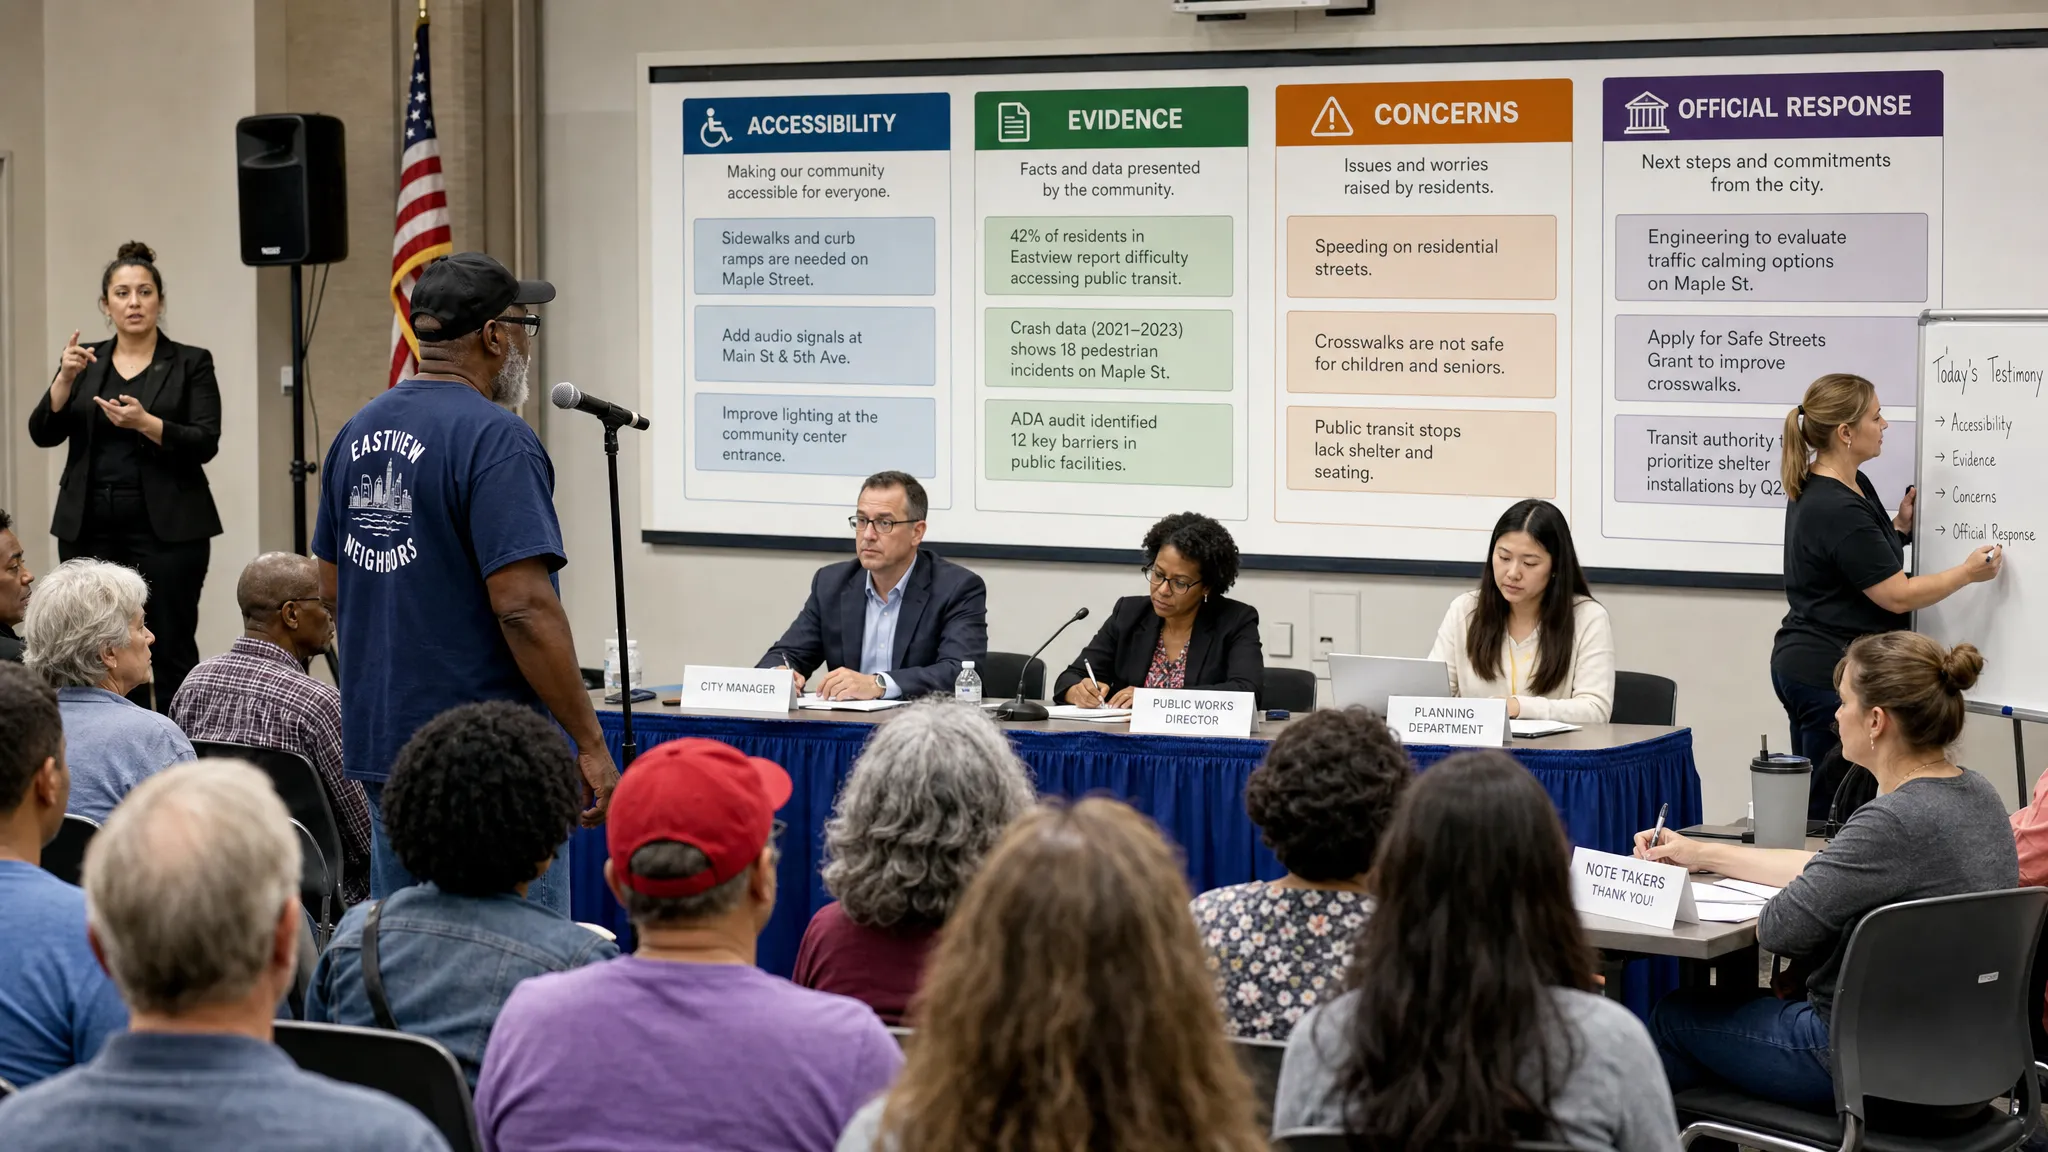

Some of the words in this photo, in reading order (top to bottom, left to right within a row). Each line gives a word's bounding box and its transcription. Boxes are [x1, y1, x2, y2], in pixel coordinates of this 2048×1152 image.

[1374, 100, 1519, 126] CONCERNS
[1678, 96, 1779, 120] OFFICIAL
[1786, 94, 1912, 118] RESPONSE
[746, 113, 897, 136] ACCESSIBILITY
[1068, 107, 1183, 131] EVIDENCE
[727, 164, 776, 182] Making
[780, 167, 804, 178] our
[807, 162, 885, 181] community
[1020, 161, 1058, 176] Facts
[1061, 160, 1088, 176] and
[1091, 160, 1123, 176] data
[1127, 159, 1201, 179] presented
[1344, 157, 1392, 173] Issues
[1396, 156, 1425, 172] and
[1429, 156, 1489, 172] worries
[1642, 153, 1681, 170] Next
[1686, 154, 1732, 173] steps
[1736, 152, 1768, 169] and
[1773, 152, 1891, 169] commitments
[727, 184, 798, 200] accessible
[801, 184, 822, 199] for
[824, 187, 890, 202] everyone.
[1043, 182, 1060, 201] by
[1063, 182, 1088, 197] the
[1091, 181, 1175, 200] community.
[1344, 179, 1390, 195] raised
[1395, 179, 1414, 199] by
[1418, 178, 1494, 195] residents.
[1710, 175, 1750, 193] from
[1755, 175, 1784, 192] the
[1789, 175, 1824, 196] city.
[721, 230, 790, 245] Sidewalks
[794, 230, 820, 245] and
[824, 230, 856, 245] curb
[1009, 228, 1041, 243] 42%
[1044, 228, 1060, 243] of
[1063, 228, 1128, 243] residents
[1132, 228, 1145, 243] in
[1648, 228, 1750, 249] Engineering
[1754, 230, 1772, 245] to
[1777, 228, 1847, 245] evaluate
[1315, 238, 1388, 258] Speeding
[1392, 242, 1412, 254] on
[1417, 238, 1498, 254] residential
[722, 255, 765, 269] ramps
[768, 255, 790, 266] are
[794, 251, 846, 266] needed
[850, 255, 869, 266] on
[1010, 249, 1073, 264] Eastview
[1077, 250, 1121, 268] report
[1124, 249, 1189, 268] difficulty
[1647, 251, 1696, 268] traffic
[1701, 252, 1766, 273] calming
[1771, 252, 1834, 273] options
[1010, 270, 1080, 289] accessing
[1084, 270, 1127, 289] public
[1130, 270, 1182, 286] transit.
[1315, 262, 1372, 277] streets.
[722, 271, 765, 290] Maple
[768, 271, 814, 287] Street.
[1647, 279, 1669, 291] on
[1674, 275, 1726, 296] Maple
[1731, 275, 1754, 292] St.
[721, 327, 750, 343] Add
[754, 328, 793, 343] audio
[796, 329, 845, 347] signals
[848, 331, 863, 344] at
[1010, 320, 1051, 335] Crash
[1055, 320, 1087, 336] data
[1314, 333, 1405, 350] Crosswalks
[1409, 339, 1435, 351] are
[1439, 337, 1466, 351] not
[1470, 335, 1504, 352] safe
[1647, 329, 1696, 350] Apply
[1699, 329, 1723, 346] for
[1727, 330, 1764, 347] Safe
[1768, 330, 1826, 348] Streets
[722, 347, 756, 363] Main
[759, 348, 775, 364] St
[778, 349, 789, 364] &
[792, 349, 816, 364] 5th
[819, 349, 851, 365] Ave.
[1010, 341, 1057, 357] shows
[1060, 342, 1077, 357] 18
[1081, 342, 1158, 361] pedestrian
[1010, 362, 1075, 378] incidents
[1078, 367, 1096, 378] on
[1101, 363, 1146, 383] Maple
[1150, 364, 1170, 380] St.
[1314, 355, 1337, 371] for
[1341, 356, 1404, 373] children
[1408, 357, 1438, 373] and
[1443, 358, 1505, 375] seniors.
[1647, 351, 1694, 369] Grant
[1697, 354, 1715, 369] to
[1720, 353, 1786, 374] improve
[1647, 376, 1741, 392] crosswalks.
[1932, 354, 1978, 396] Today's
[1986, 354, 2044, 398] Testimony
[722, 405, 778, 424] Improve
[782, 407, 834, 426] lighting
[837, 410, 852, 423] at
[854, 408, 878, 424] the
[1010, 411, 1045, 427] ADA
[1048, 412, 1086, 428] audit
[1090, 413, 1158, 430] identified
[1950, 411, 2013, 440] Accessibility
[722, 427, 800, 446] community
[802, 430, 848, 444] center
[1315, 419, 1362, 436] Public
[1365, 421, 1415, 437] transit
[1419, 423, 1462, 442] stops
[1646, 428, 1699, 446] Transit
[1702, 431, 1775, 453] authority
[350, 429, 426, 464] EASTVIEW
[1010, 432, 1027, 447] 12
[1031, 432, 1057, 452] key
[1062, 433, 1119, 450] barriers
[1124, 435, 1137, 450] in
[1314, 441, 1345, 457] lack
[1348, 442, 1401, 459] shelter
[1404, 444, 1433, 460] and
[722, 448, 786, 463] entrance.
[1011, 454, 1056, 472] public
[1059, 454, 1126, 472] facilities.
[1647, 452, 1714, 472] prioritize
[1718, 454, 1771, 472] shelter
[1952, 449, 1997, 467] Evidence
[1314, 464, 1374, 484] seating.
[1647, 475, 1735, 494] installations
[1738, 478, 1757, 499] by
[1760, 479, 1786, 497] Q2.
[1952, 485, 1997, 504] Concerns
[1952, 522, 1987, 540] Official
[1991, 522, 2037, 547] Response
[343, 533, 418, 573] NEIGHBORS
[700, 681, 724, 692] CITY
[725, 682, 776, 695] MANAGER
[1152, 698, 1192, 710] PUBLIC
[1194, 699, 1234, 711] WORKS
[1414, 706, 1475, 719] PLANNING
[1165, 713, 1219, 726] DIRECTOR
[1408, 722, 1484, 735] DEPARTMENT
[1585, 861, 1618, 881] NOTE
[1621, 868, 1666, 890] TAKERS
[1592, 883, 1628, 902] THANK
[1629, 891, 1655, 907] YOU!
